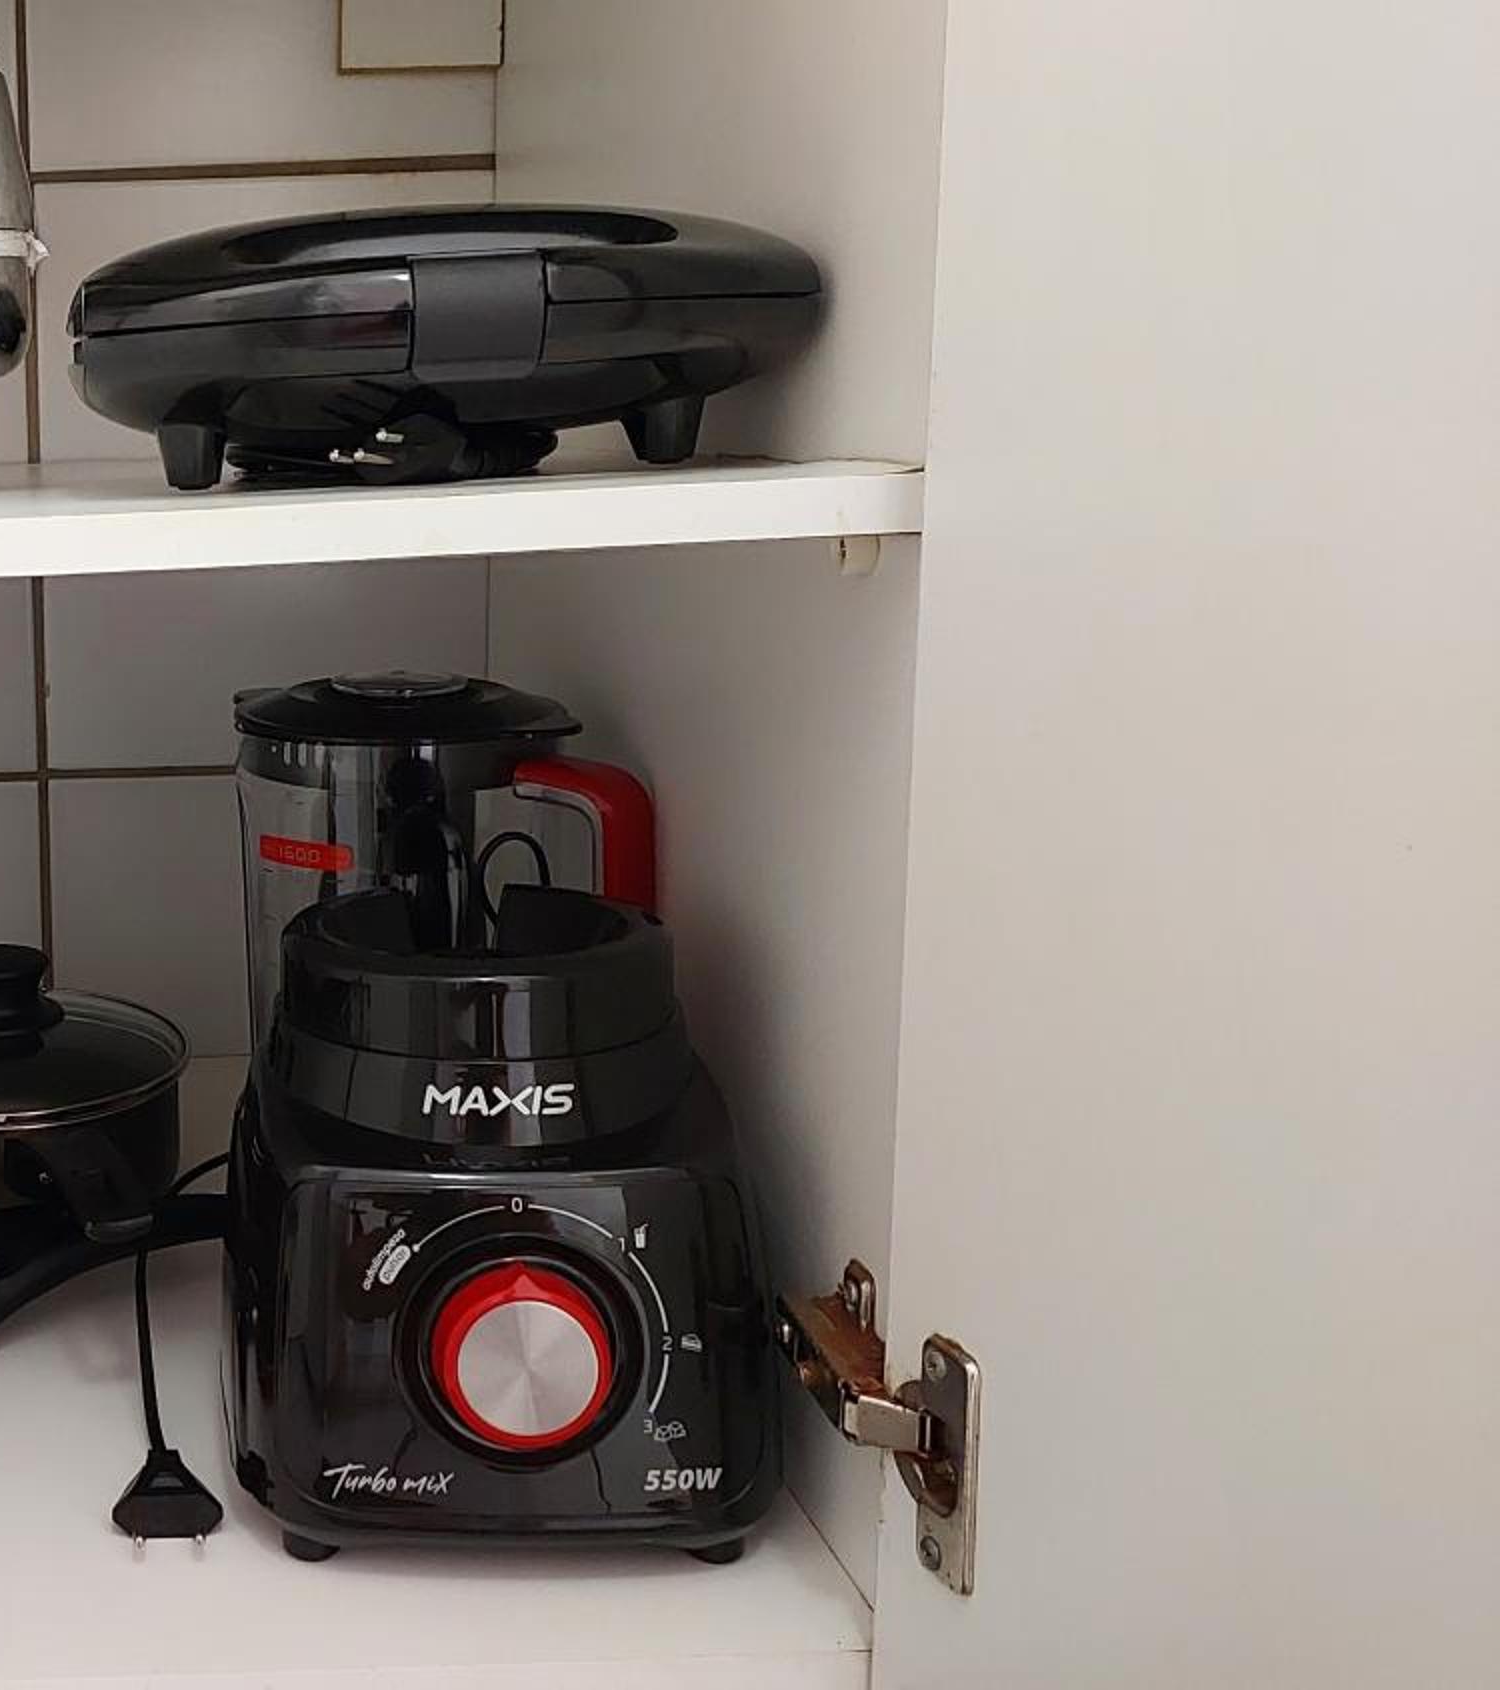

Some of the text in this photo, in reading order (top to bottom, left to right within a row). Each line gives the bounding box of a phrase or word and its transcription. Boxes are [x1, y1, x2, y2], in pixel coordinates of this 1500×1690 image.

[422, 1083, 575, 1116] MAXIS
[511, 1197, 523, 1213] 0
[617, 1237, 625, 1253] 1
[662, 1335, 673, 1351] 2
[643, 1419, 653, 1434] 3
[323, 1463, 397, 1499] Turbo
[643, 1467, 723, 1491] 550W
